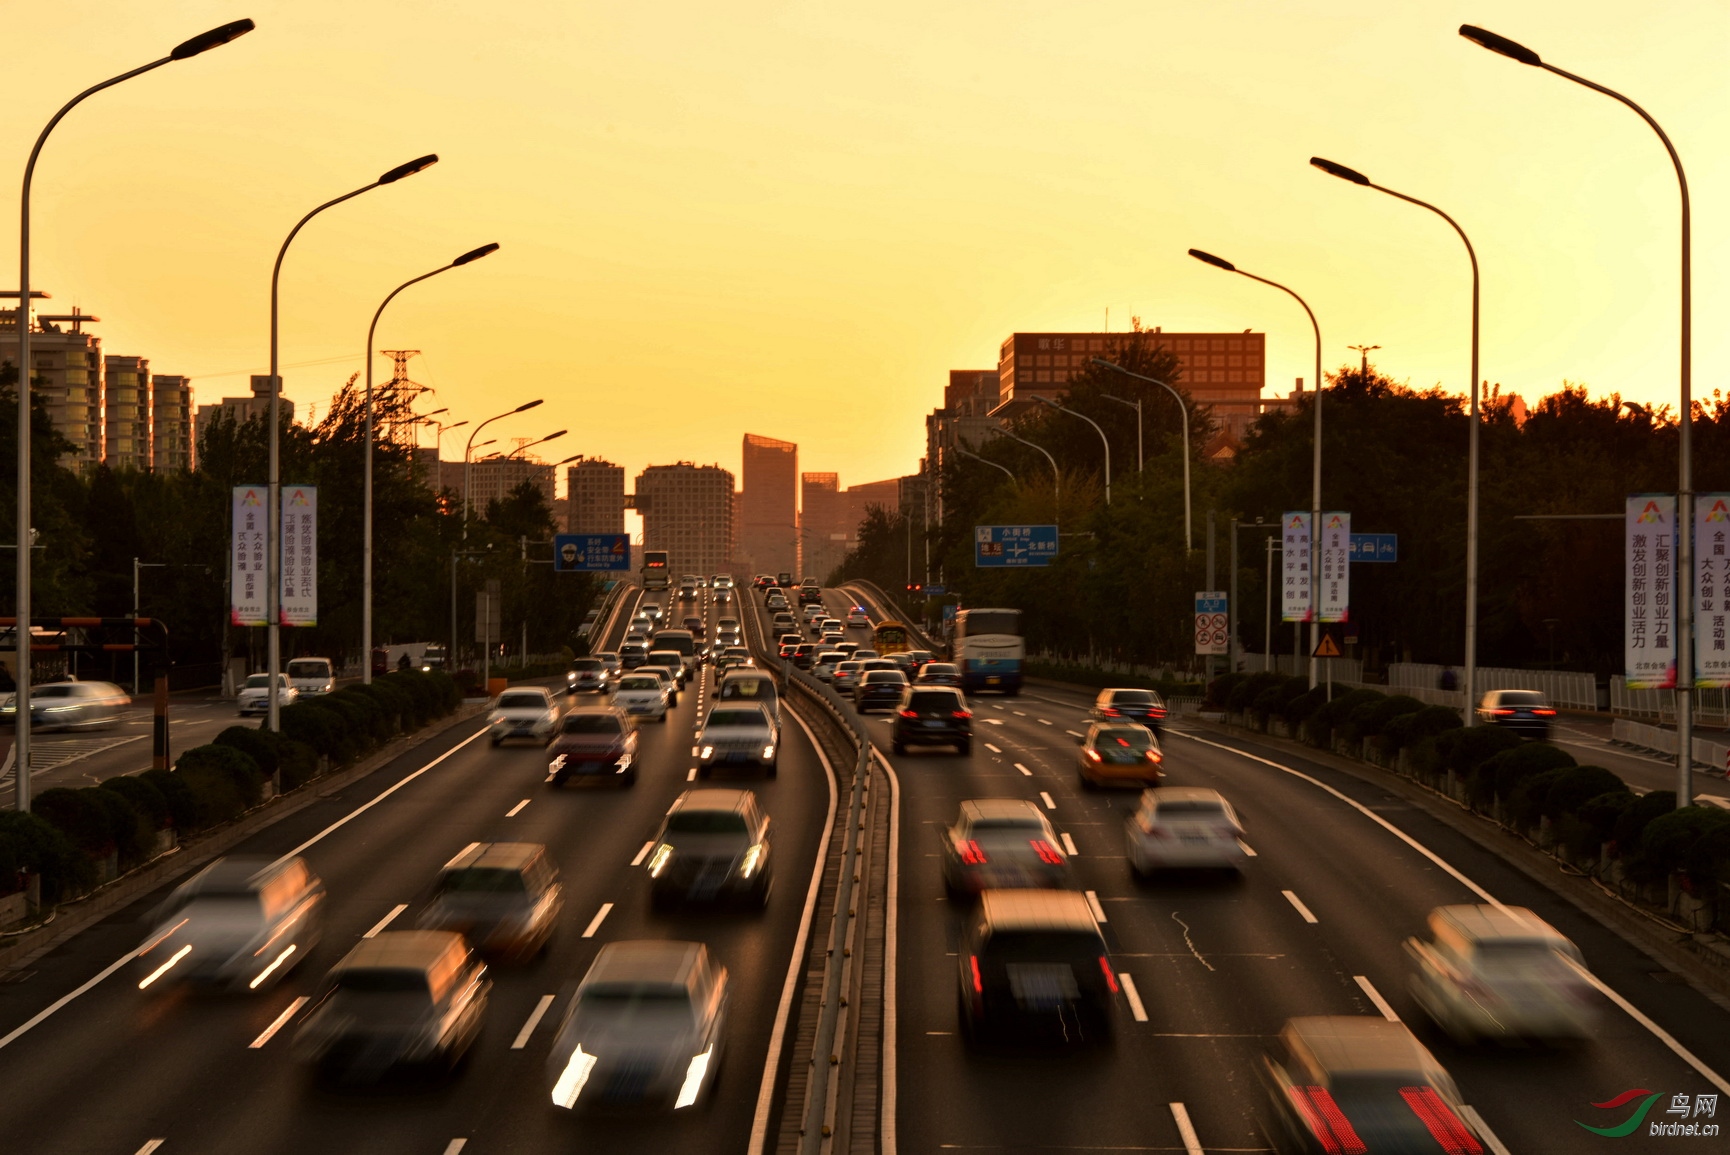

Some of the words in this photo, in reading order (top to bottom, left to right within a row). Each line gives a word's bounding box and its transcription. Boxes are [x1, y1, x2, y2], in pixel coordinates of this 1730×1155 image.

[1332, 533, 1339, 548] 全国
[1713, 531, 1725, 556] 全国
[1285, 535, 1295, 600] 高水平双创
[1299, 535, 1309, 600] 高质量发展
[1324, 549, 1333, 580] 大众创业
[1337, 549, 1346, 580] 万众创新
[1330, 582, 1338, 602] 活动周
[1632, 534, 1647, 649] 激发创新创业活力
[1654, 534, 1670, 649] 汇聚创新创业力量
[1701, 558, 1714, 612] 大众创业
[1713, 615, 1725, 651] 活动周
[1635, 661, 1667, 670] 北京会场
[1704, 660, 1730, 669] 北京会
